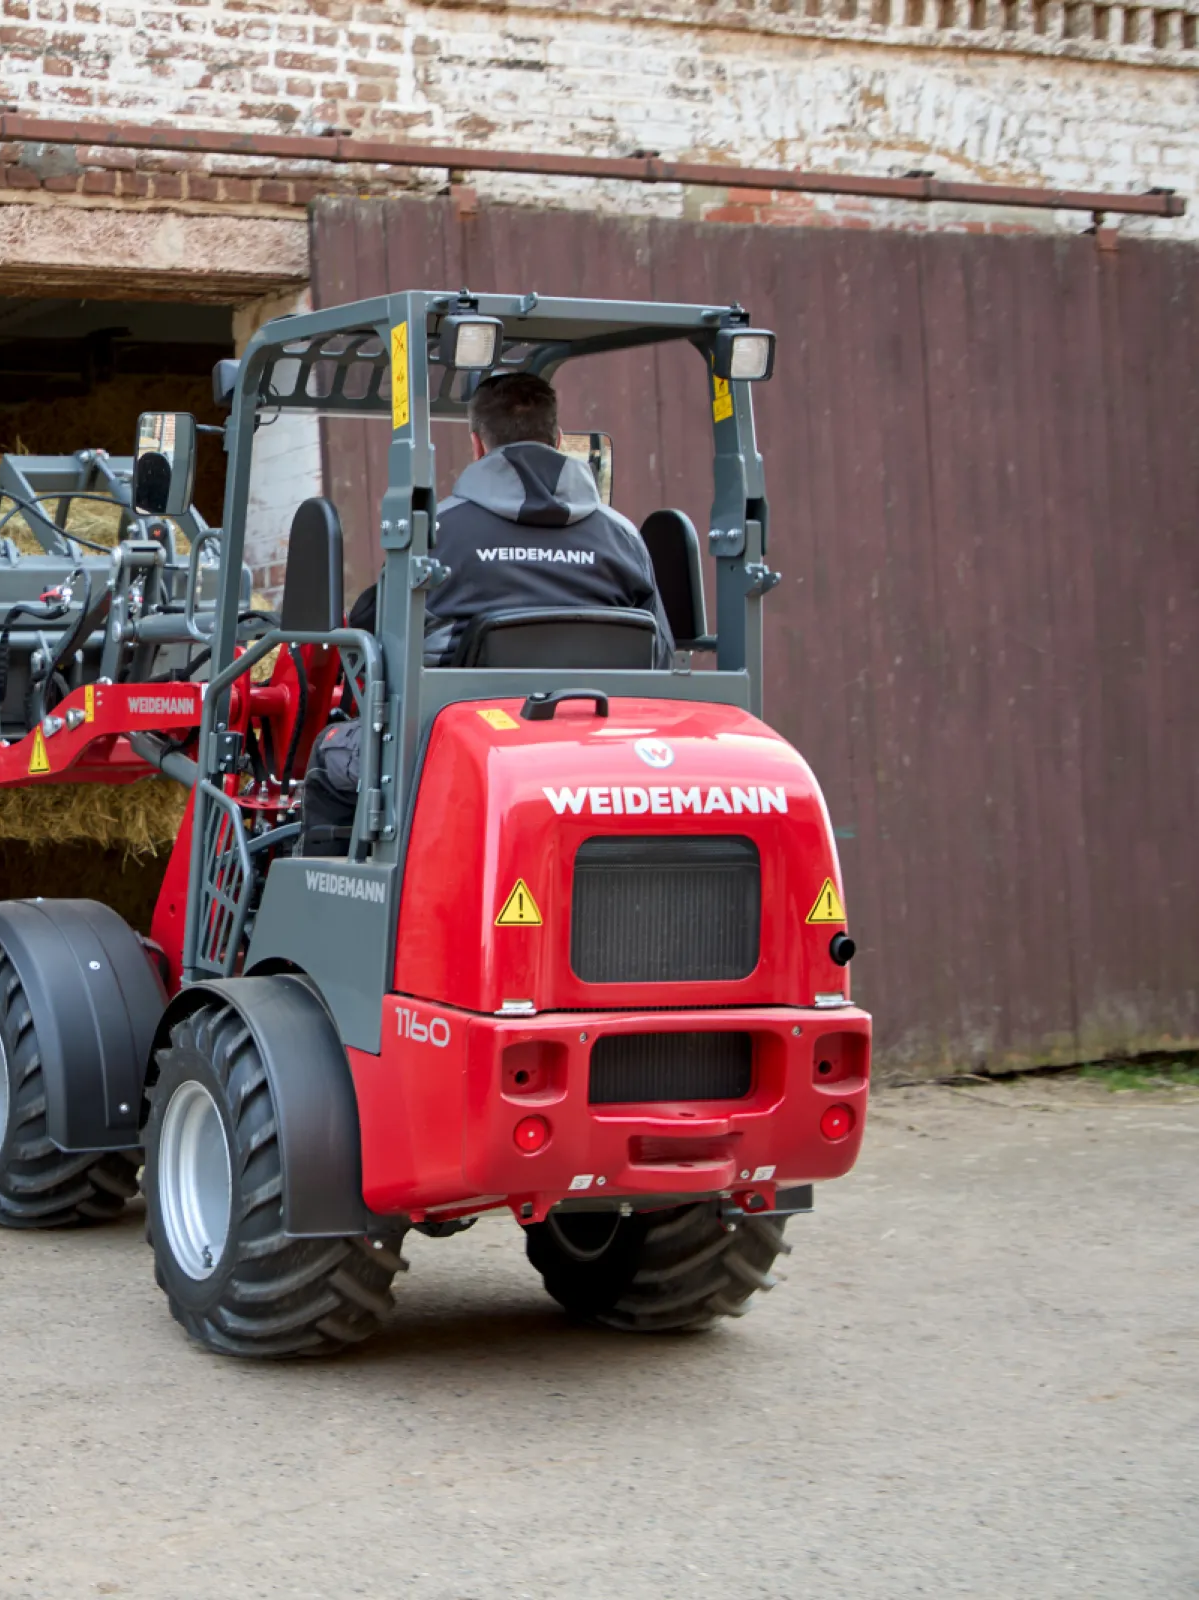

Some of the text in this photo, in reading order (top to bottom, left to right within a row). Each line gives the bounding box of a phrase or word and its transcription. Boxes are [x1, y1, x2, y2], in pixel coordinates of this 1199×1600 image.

[475, 547, 595, 565] WEIDEMANN
[128, 696, 195, 715] WEIDEMANN
[541, 785, 789, 815] WEIDEMANN
[305, 869, 386, 904] WEIDEMANN
[395, 1006, 451, 1048] 1160
